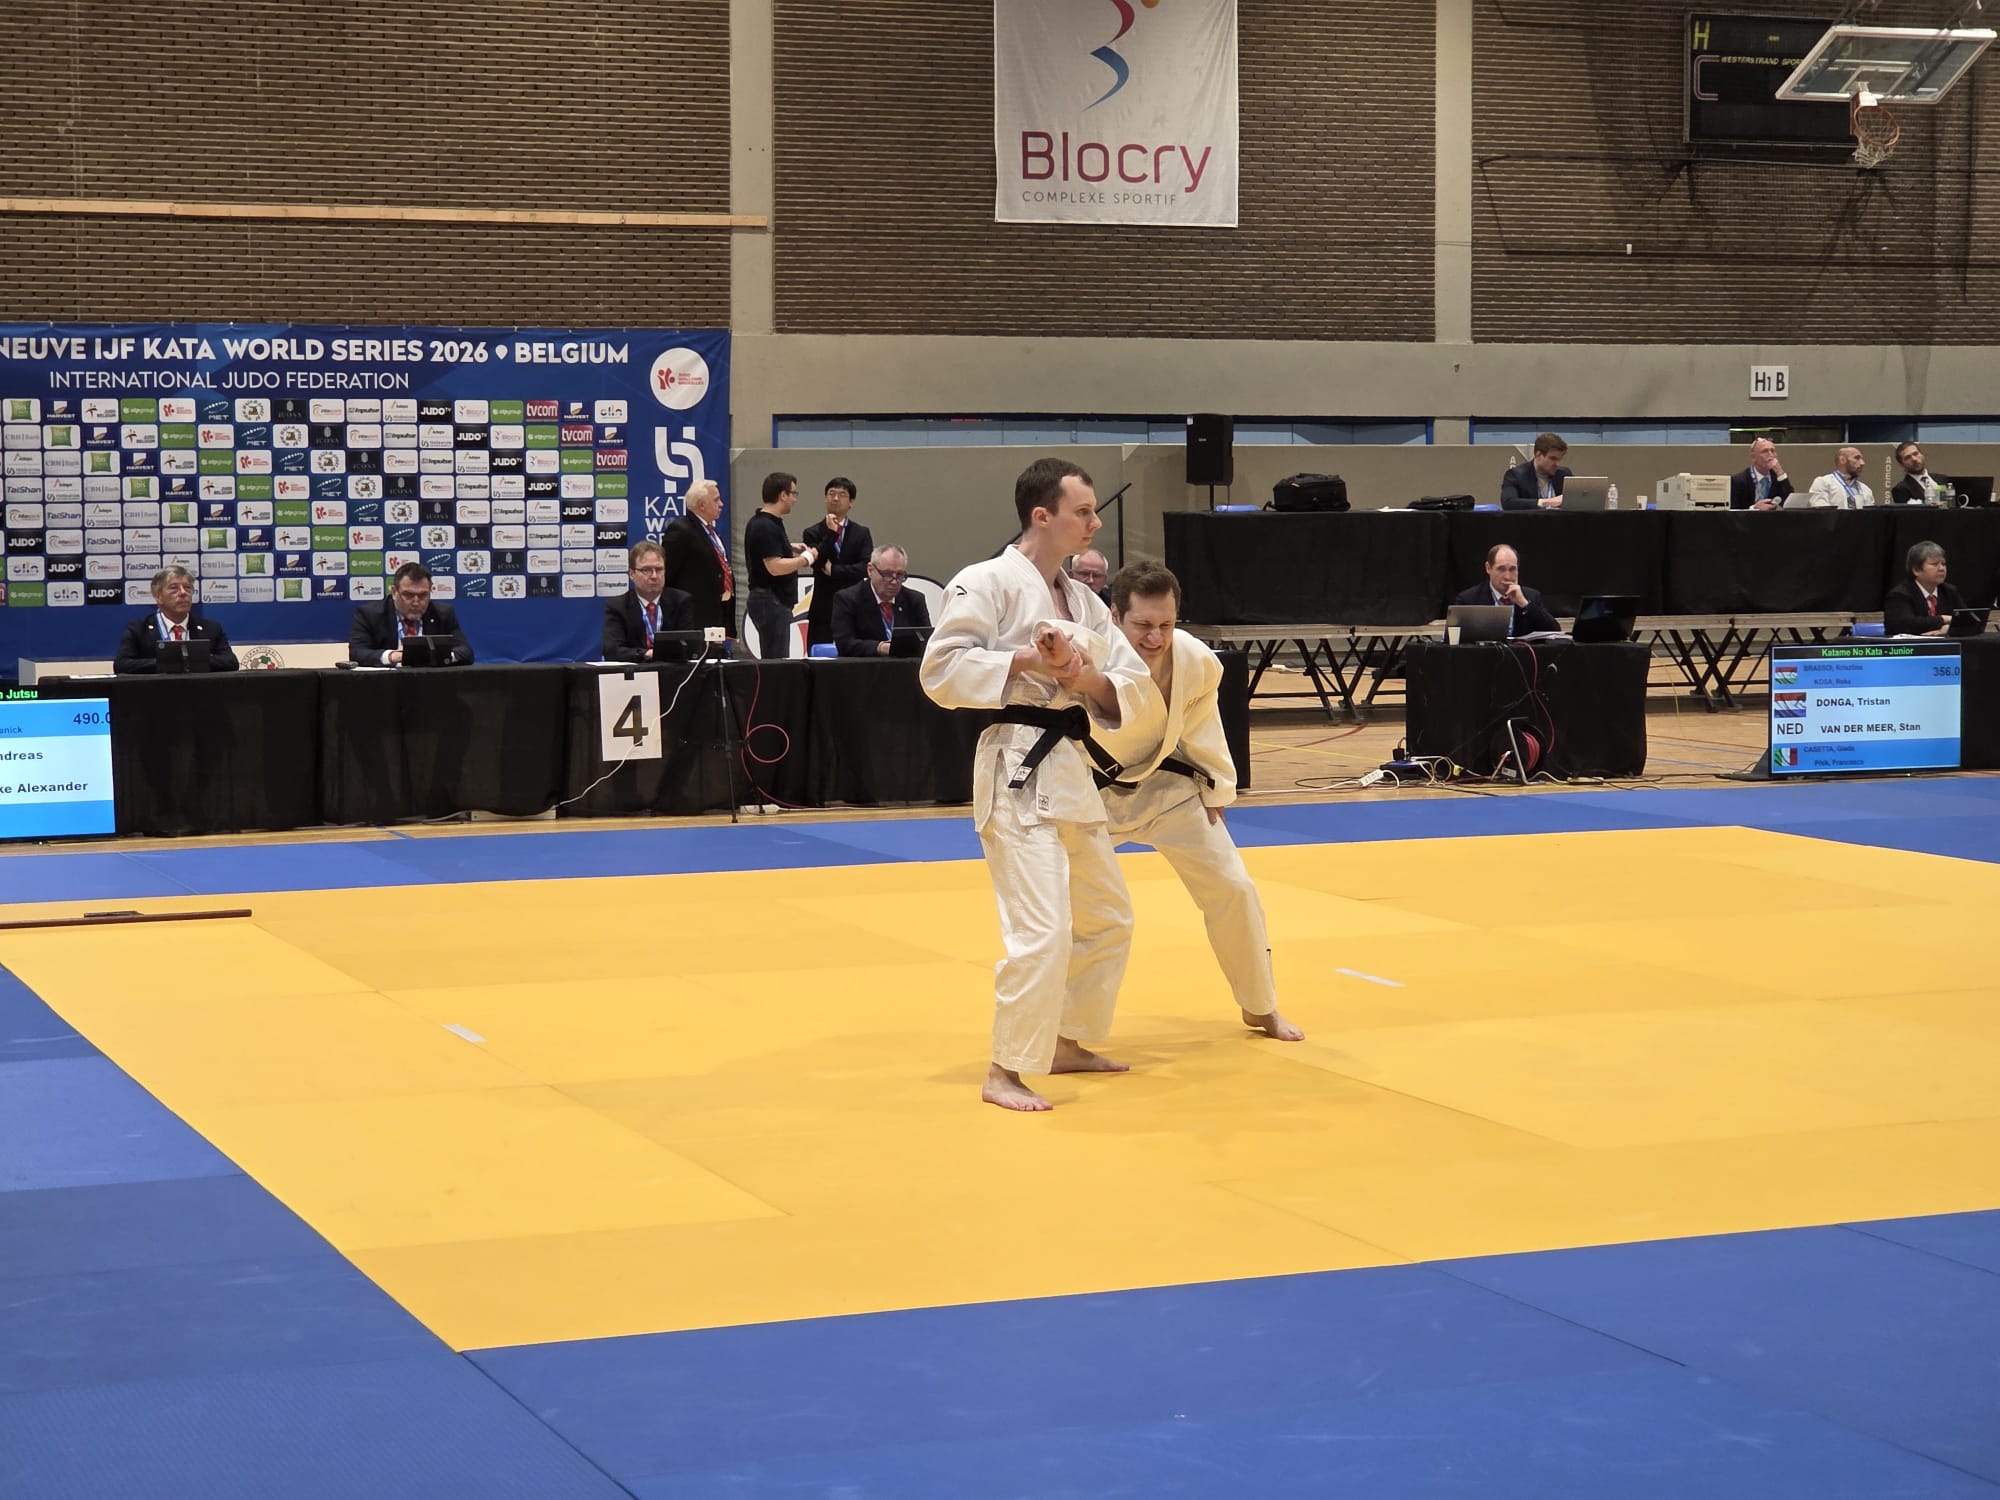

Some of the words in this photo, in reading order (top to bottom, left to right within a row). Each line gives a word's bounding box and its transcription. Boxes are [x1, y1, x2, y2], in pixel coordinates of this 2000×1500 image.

[1721, 56, 1779, 65] WESTERSTRAND
[1782, 58, 1804, 66] SPOR
[1021, 131, 1212, 193] Blocry
[1022, 191, 1105, 204] COMPLEXE
[1114, 193, 1177, 206] SPORTIF
[95, 338, 136, 360] IJF
[143, 338, 216, 360] KATA
[222, 339, 324, 361] WORLD
[331, 339, 424, 362] SERIES
[429, 341, 489, 363] 2026
[515, 342, 629, 364] BELGIUM
[50, 371, 217, 388] INTERNATIONAL
[222, 371, 280, 389] JUDO
[287, 371, 409, 390] FEDERATION
[1776, 371, 1786, 392] B
[526, 404, 557, 416] tvcom
[562, 428, 592, 441] tvcom
[596, 453, 627, 465] tvcom
[645, 496, 687, 517] KAT
[1821, 648, 1850, 657] Katame
[1852, 648, 1864, 656] No
[1865, 648, 1882, 656] Kata
[1889, 647, 1914, 656] Junior
[1933, 666, 1960, 677] 356.0
[6, 690, 38, 699] Jutsu
[1816, 698, 1854, 708] DONGA,
[1857, 698, 1891, 706] Tristan
[613, 695, 649, 747] 4
[1777, 723, 1804, 735] NED
[1820, 726, 1841, 734] VAN
[1844, 724, 1864, 732] DER
[1866, 724, 1896, 734] MEER,
[1899, 723, 1921, 732] Stan
[18, 782, 88, 793] Alexander
